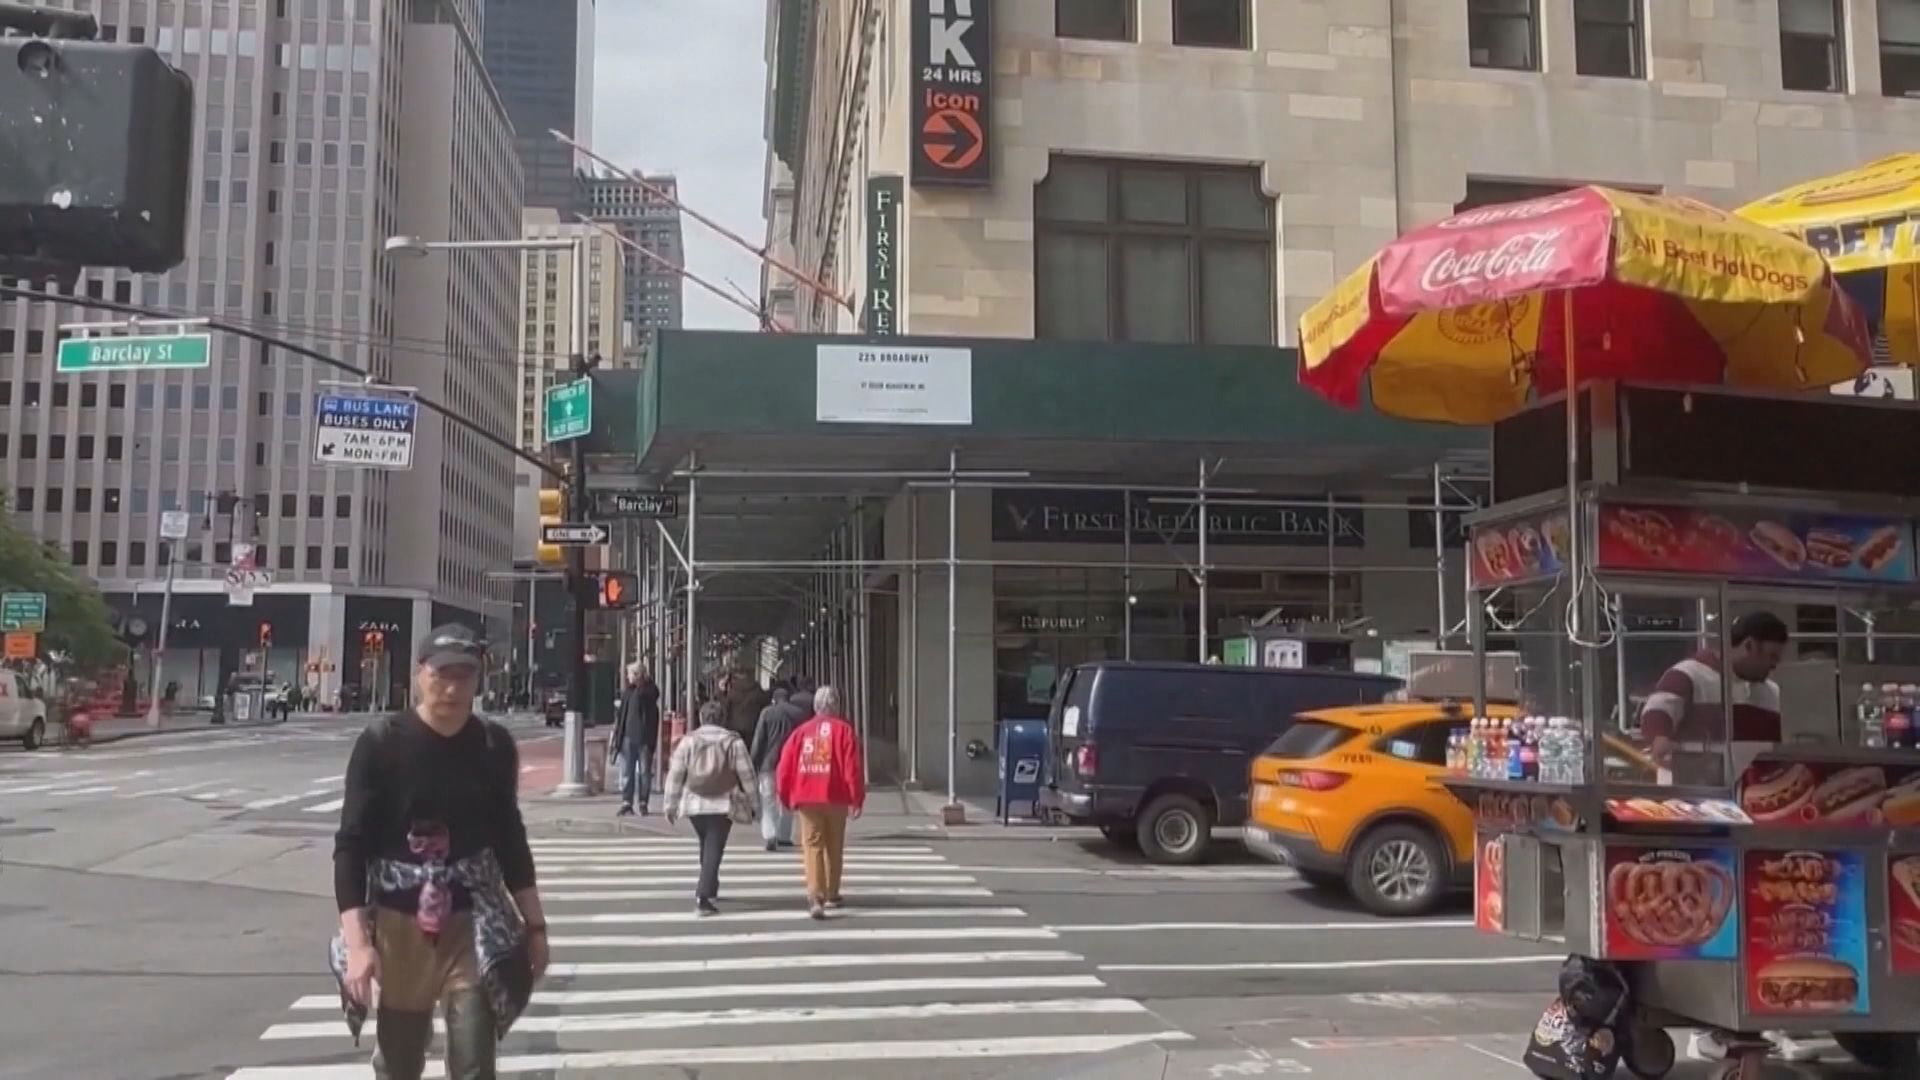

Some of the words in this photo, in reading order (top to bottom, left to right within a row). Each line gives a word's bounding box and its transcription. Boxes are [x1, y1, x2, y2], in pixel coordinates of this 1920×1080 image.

[923, 67, 942, 81] 24
[948, 69, 982, 84] HRS
[875, 190, 891, 280] FIRST
[1421, 225, 1566, 292] Coca-Cola
[1633, 234, 1657, 256] All
[1664, 240, 1706, 267] Beef
[1712, 253, 1749, 278] Hot
[1751, 263, 1809, 292] Dogs
[91, 344, 151, 363] Barclay
[157, 343, 173, 360] St
[880, 353, 929, 364] BROADWAY
[343, 400, 370, 414] BUS
[374, 402, 411, 417] LANE
[324, 413, 369, 428] BUSES
[373, 417, 408, 430] ONLY
[618, 496, 663, 514] Barclay
[580, 530, 600, 538] WAY
[359, 621, 400, 632] ZARA
